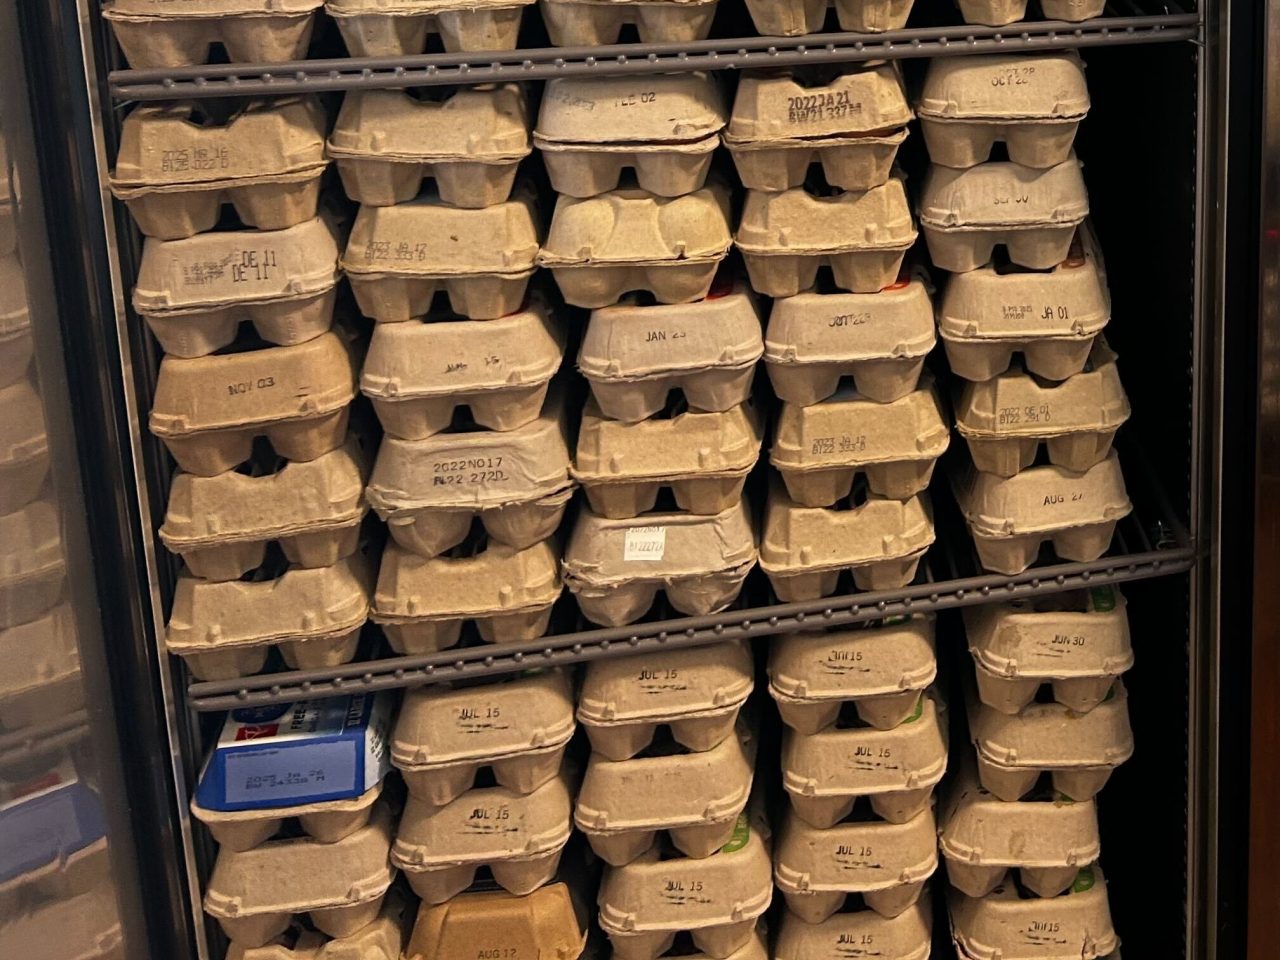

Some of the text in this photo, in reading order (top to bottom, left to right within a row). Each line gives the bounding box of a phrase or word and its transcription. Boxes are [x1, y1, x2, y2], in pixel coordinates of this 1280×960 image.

[641, 92, 656, 103] 02
[1041, 306, 1056, 320] JA
[1057, 306, 1070, 320] 01
[228, 377, 275, 396] NOV 03
[433, 456, 503, 472] 2022NO17
[1043, 494, 1065, 507] AUG
[1071, 636, 1085, 647] 30
[637, 668, 677, 681] JUL 15
[458, 707, 501, 720] JUL 15
[854, 746, 872, 757] JUL
[470, 808, 510, 820] JUL 15
[835, 845, 872, 857] JUL 15
[689, 880, 703, 892] 15
[837, 933, 873, 945] JUL 15
